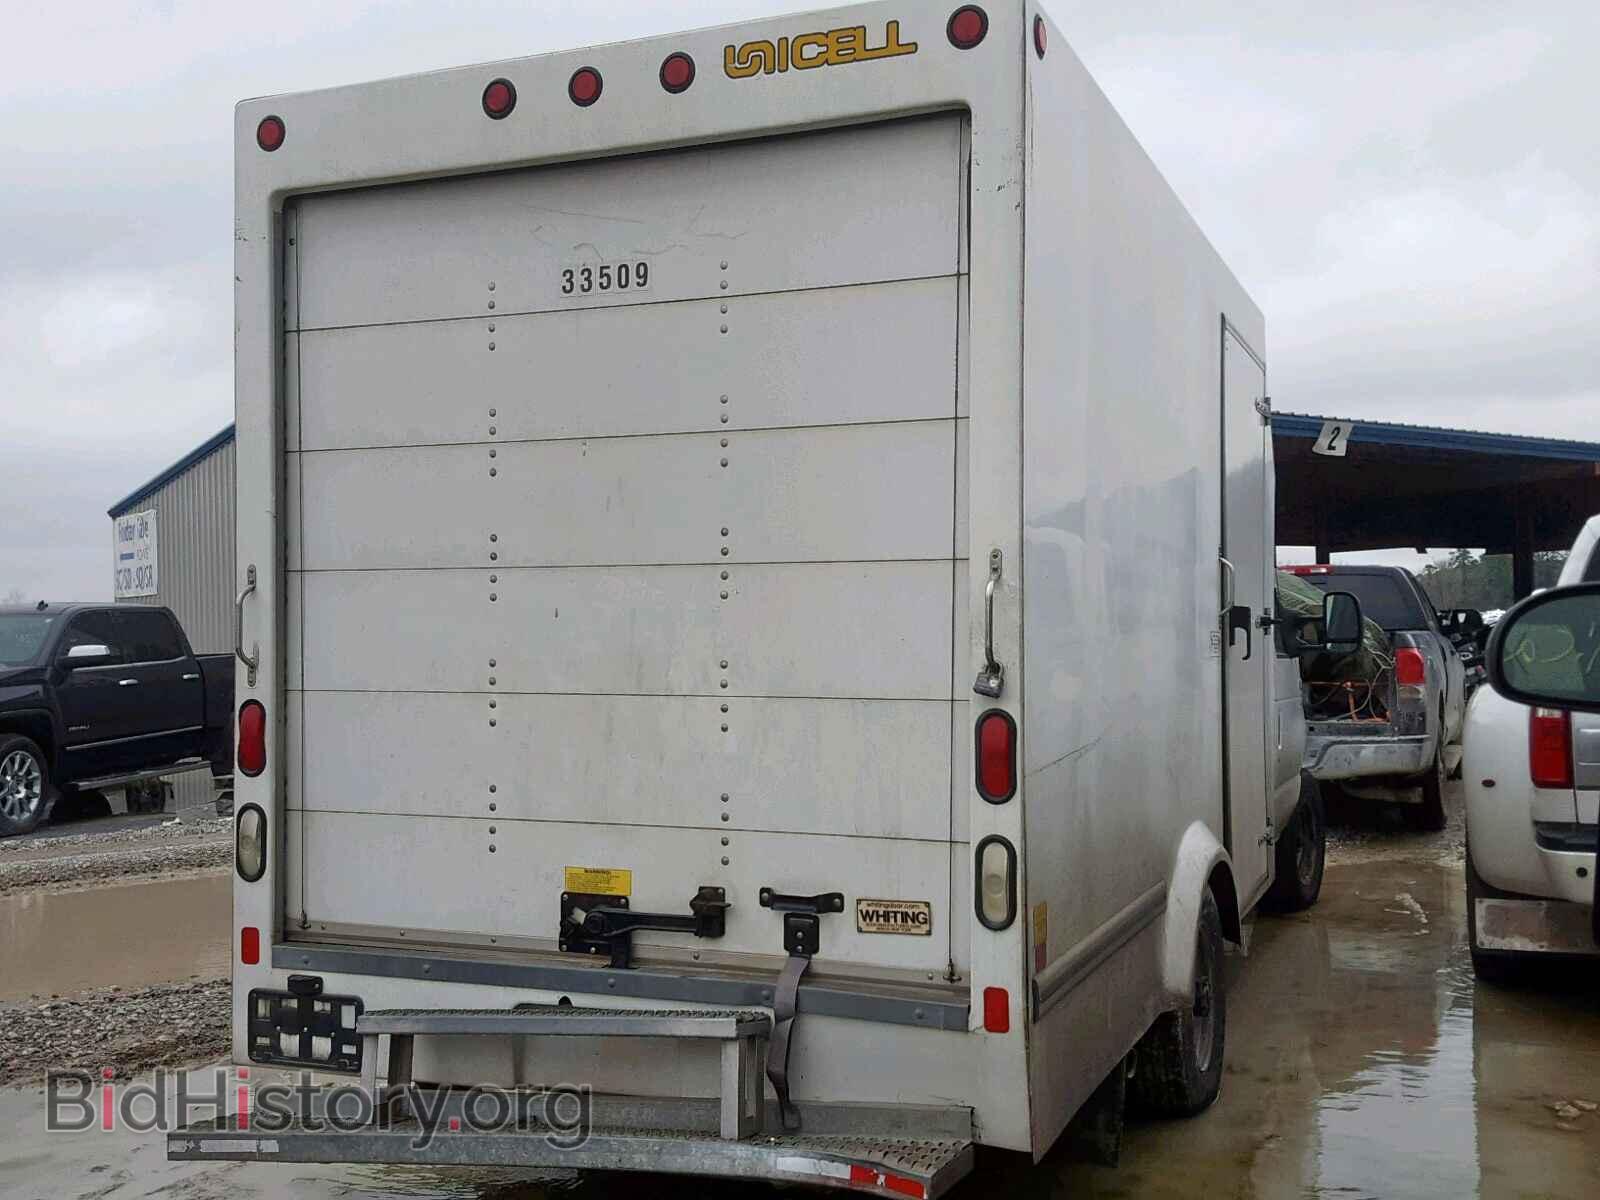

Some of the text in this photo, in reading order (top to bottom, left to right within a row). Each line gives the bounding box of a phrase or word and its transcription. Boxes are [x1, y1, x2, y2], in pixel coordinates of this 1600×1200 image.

[724, 20, 918, 79] UNICELL
[561, 262, 649, 294] 33509
[1327, 426, 1341, 451] 2
[859, 908, 929, 926] WHITING
